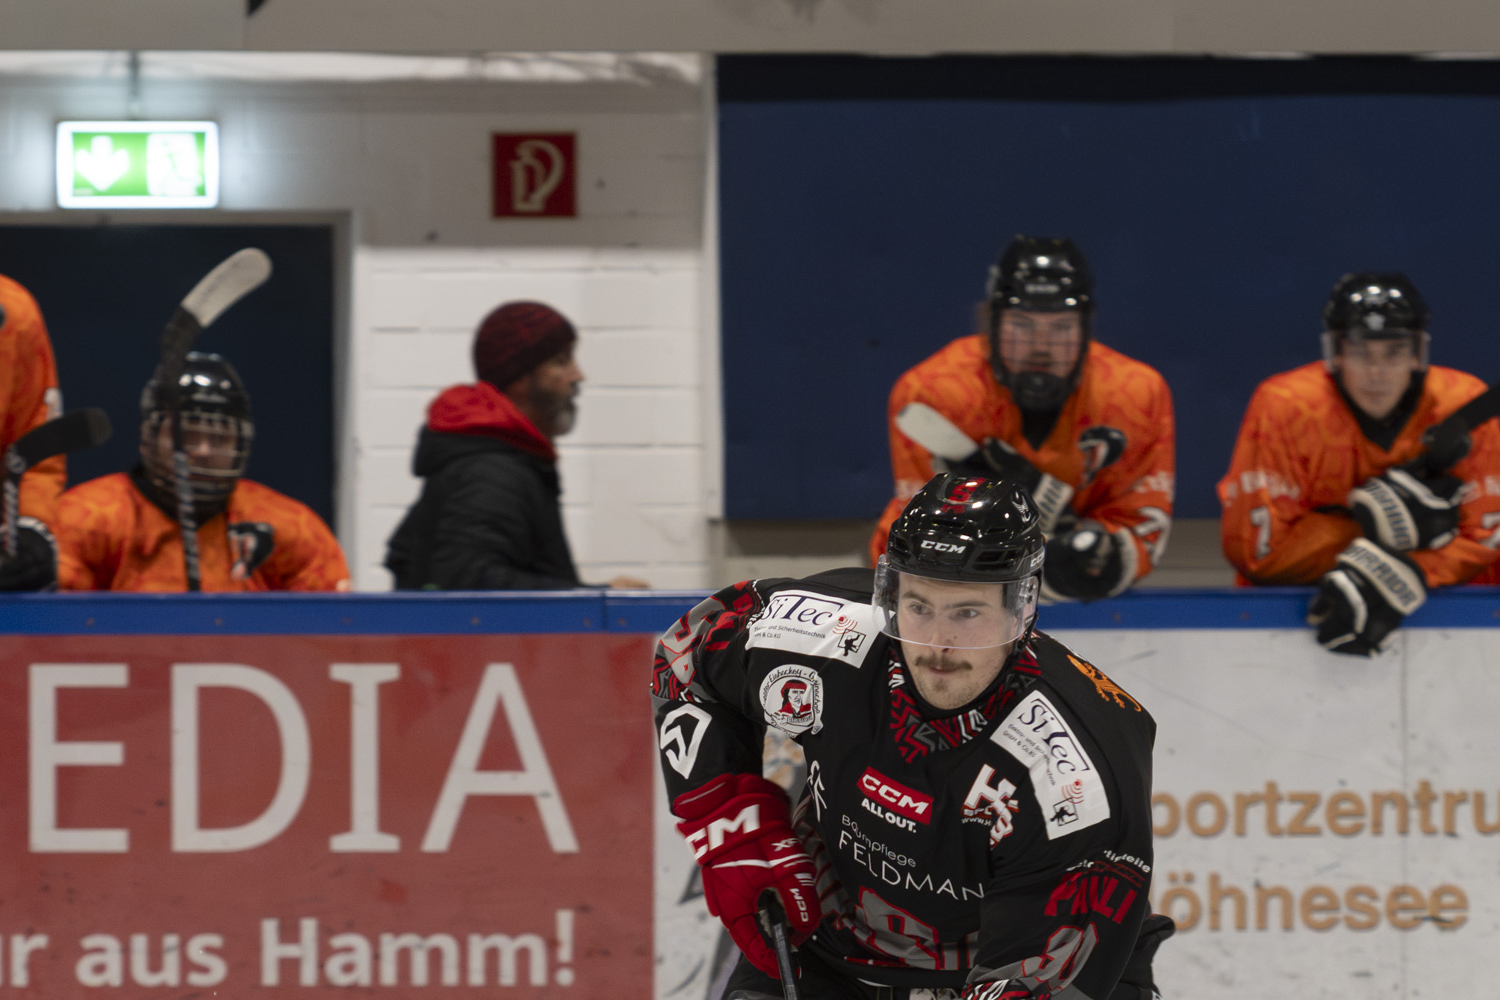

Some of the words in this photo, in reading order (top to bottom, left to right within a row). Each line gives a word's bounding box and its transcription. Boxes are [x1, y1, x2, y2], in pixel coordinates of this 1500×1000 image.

[920, 540, 966, 554] CCM
[762, 594, 844, 626] SiTec
[1017, 698, 1091, 775] SiTec
[862, 774, 930, 815] CCM
[842, 814, 917, 868] Baumpflege
[1151, 872, 1470, 932] öhnesee
[75, 929, 228, 988] aus
[260, 909, 576, 988] Hamm!
